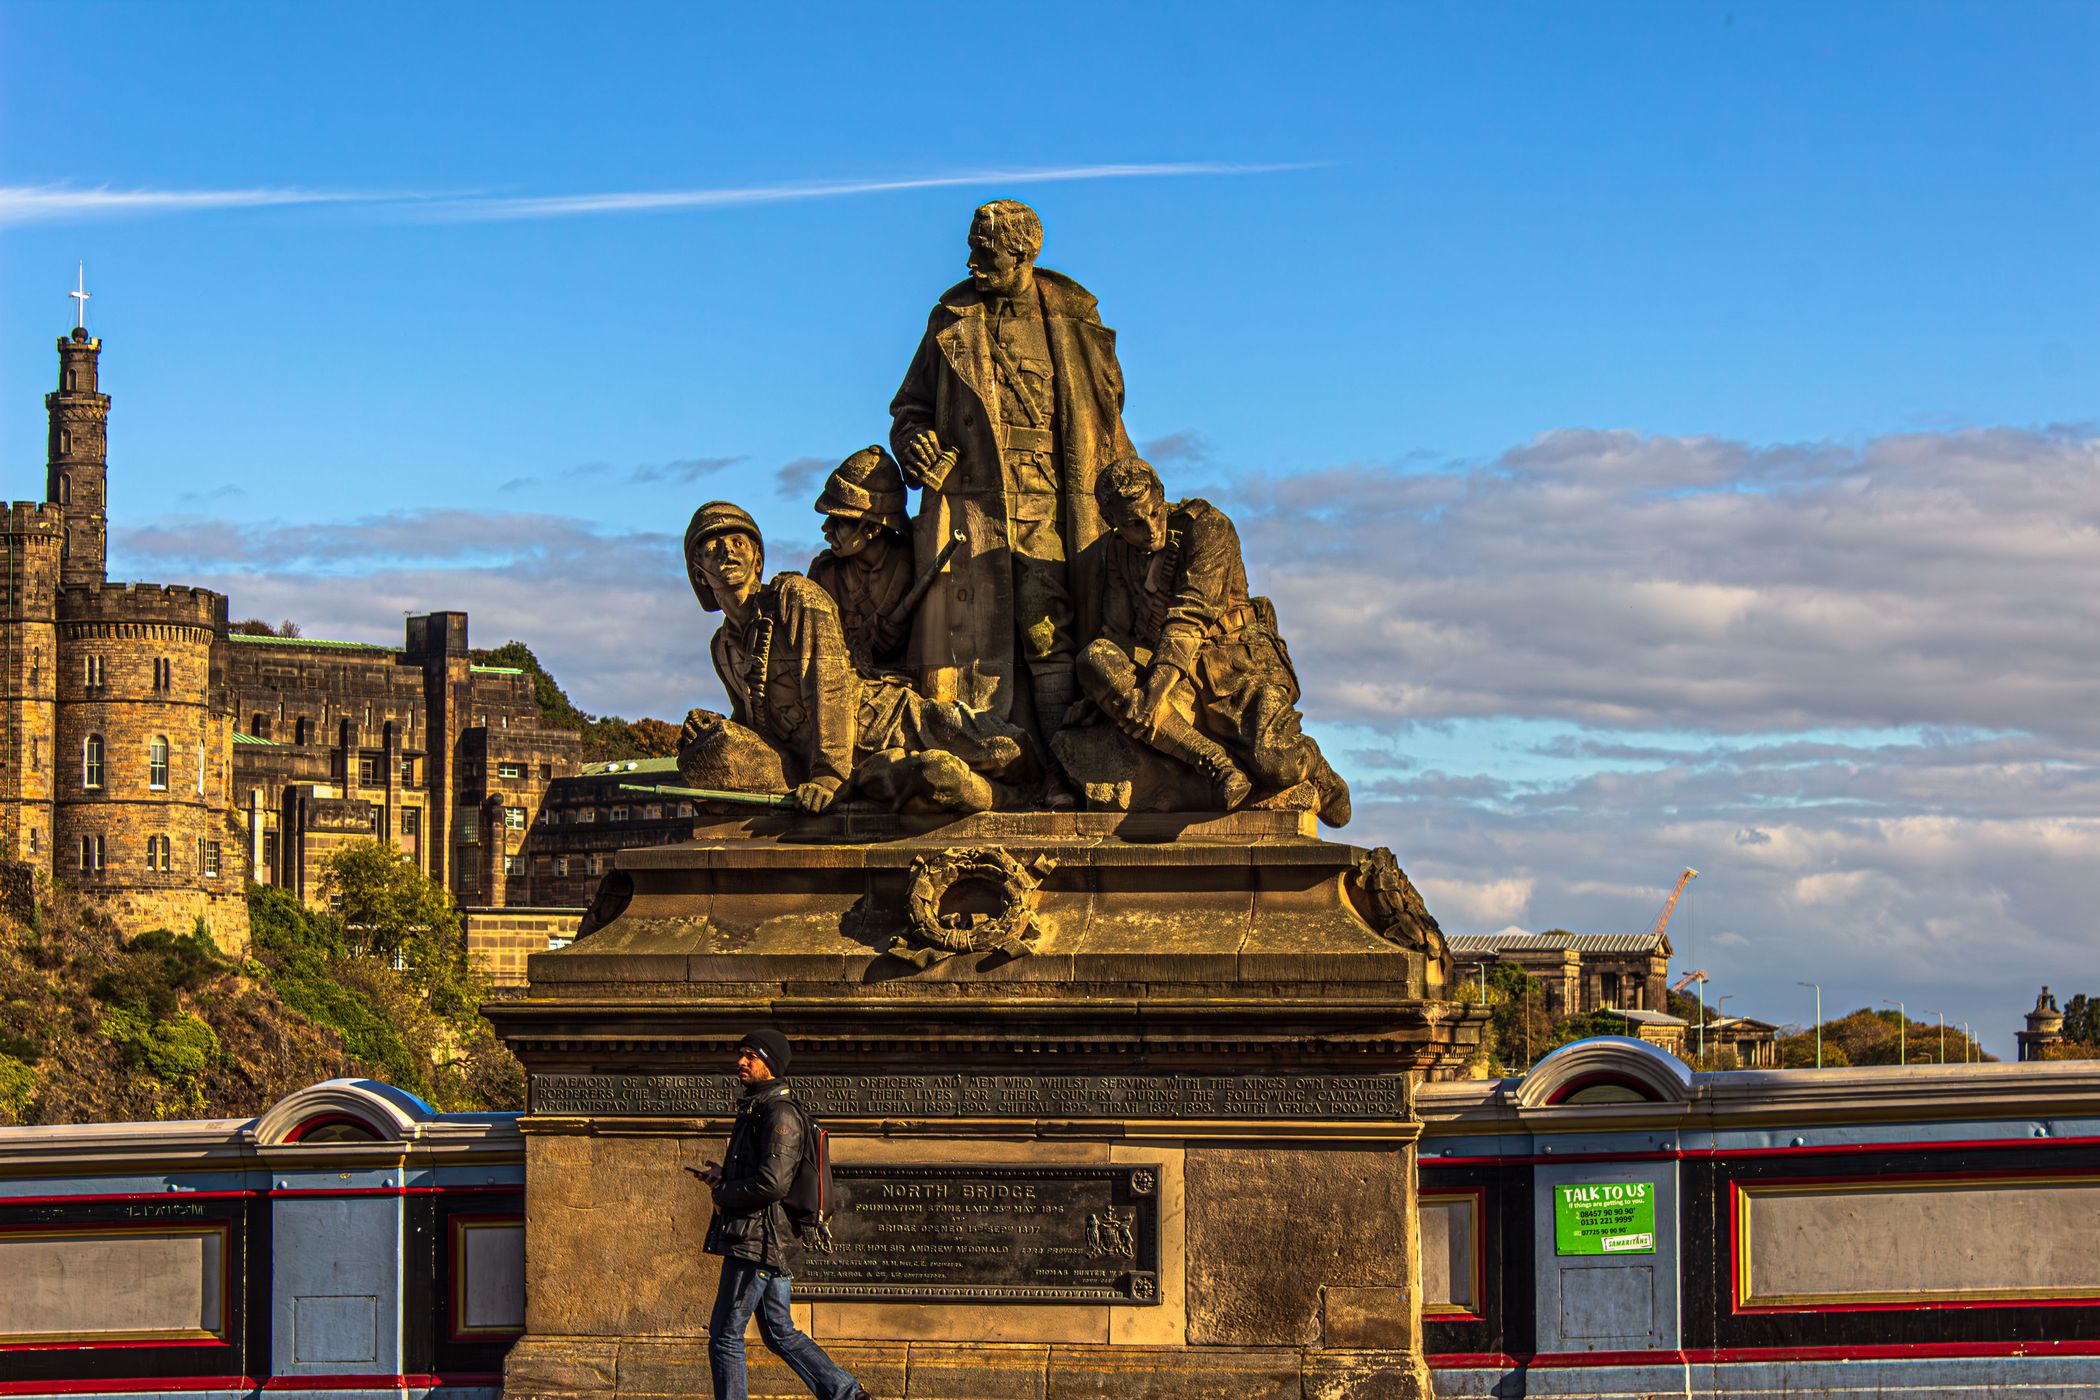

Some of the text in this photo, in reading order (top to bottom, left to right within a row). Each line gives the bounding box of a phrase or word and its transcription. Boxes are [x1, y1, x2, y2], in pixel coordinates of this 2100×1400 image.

[538, 1076, 552, 1088] IN
[557, 1076, 613, 1088] MEMORY
[622, 1076, 638, 1088] OF
[648, 1076, 713, 1088] OFFICERS
[859, 1077, 925, 1089] OFFICERS
[934, 1077, 961, 1089] AND
[968, 1077, 998, 1089] MEN
[1004, 1077, 1033, 1089] WHO
[1040, 1077, 1090, 1089] WHILST
[1100, 1077, 1159, 1089] SERVING
[1166, 1077, 1200, 1089] WITH
[1209, 1077, 1234, 1089] THE
[1244, 1077, 1286, 1089] KING'S
[1295, 1077, 1324, 1089] OWN
[1332, 1077, 1397, 1089] SCOTTISH
[538, 1088, 614, 1100] BORDERERS
[622, 1088, 650, 1100] (THE
[660, 1088, 733, 1100] EDINBURGH
[825, 1089, 857, 1101] GAVE
[870, 1089, 905, 1101] THEIR
[915, 1089, 953, 1101] LIVES
[963, 1089, 989, 1101] FOR
[1001, 1089, 1040, 1101] THEIR
[1051, 1089, 1115, 1101] COUNTRY
[1126, 1089, 1179, 1101] DURING
[1191, 1089, 1215, 1101] THE
[1226, 1089, 1306, 1101] FOLLOWING
[1317, 1089, 1396, 1101] CAMPAIGNS
[538, 1100, 629, 1112] AFGHANISTAN
[828, 1101, 859, 1113] CHIN
[868, 1101, 914, 1113] LUSHAI
[997, 1101, 1052, 1113] CHITRAL
[1060, 1101, 1092, 1113] 1895.
[1100, 1101, 1139, 1113] TIRAH
[1224, 1102, 1268, 1114] SOUTH
[1276, 1102, 1322, 1114] AFRICA
[881, 1184, 1036, 1199] NORTH BRIDGE
[1563, 1184, 1646, 1203] TALK TO US
[856, 1203, 923, 1213] FOUNDATION
[927, 1204, 961, 1213] STONE
[965, 1204, 989, 1213] LAID
[1013, 1205, 1037, 1214] MAY
[1041, 1205, 1064, 1214] 1896
[1580, 1209, 1601, 1218] 08457
[1603, 1209, 1613, 1217] 90
[1614, 1208, 1623, 1216] 90
[1580, 1218, 1598, 1226] 0131
[1600, 1217, 1613, 1225] 221
[877, 1224, 917, 1233] BRIDGE
[921, 1225, 963, 1233] OPENED
[1016, 1225, 1041, 1234] 1897
[1608, 1237, 1649, 1247] SAMARITANS
[833, 1243, 851, 1252] THE
[890, 1244, 905, 1253] SIR
[910, 1244, 952, 1253] ANDREW
